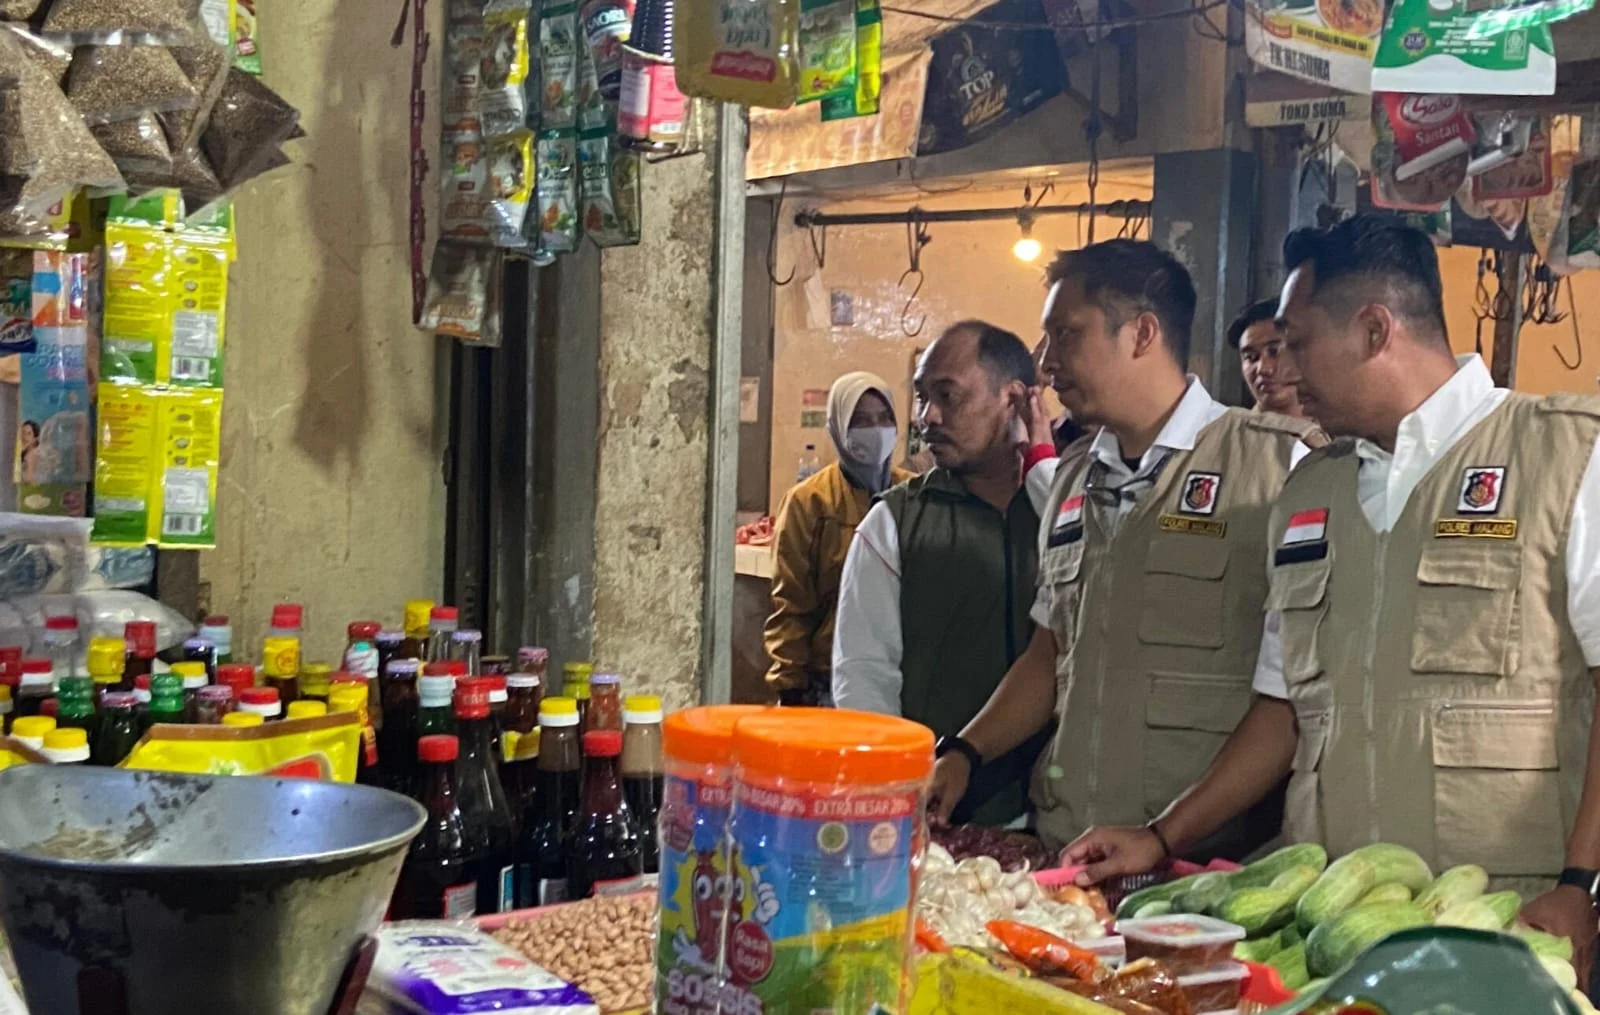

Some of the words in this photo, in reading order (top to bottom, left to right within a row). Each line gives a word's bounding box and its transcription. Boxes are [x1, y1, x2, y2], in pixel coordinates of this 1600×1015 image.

[959, 71, 994, 100] TOP
[1280, 102, 1310, 121] TOKO
[1312, 100, 1346, 118] SUMA
[1415, 123, 1460, 147] Santan
[1439, 521, 1471, 534] POLRES
[1472, 522, 1513, 535] MALANG
[814, 798, 852, 816] EXTRA
[853, 799, 890, 816] BESAR
